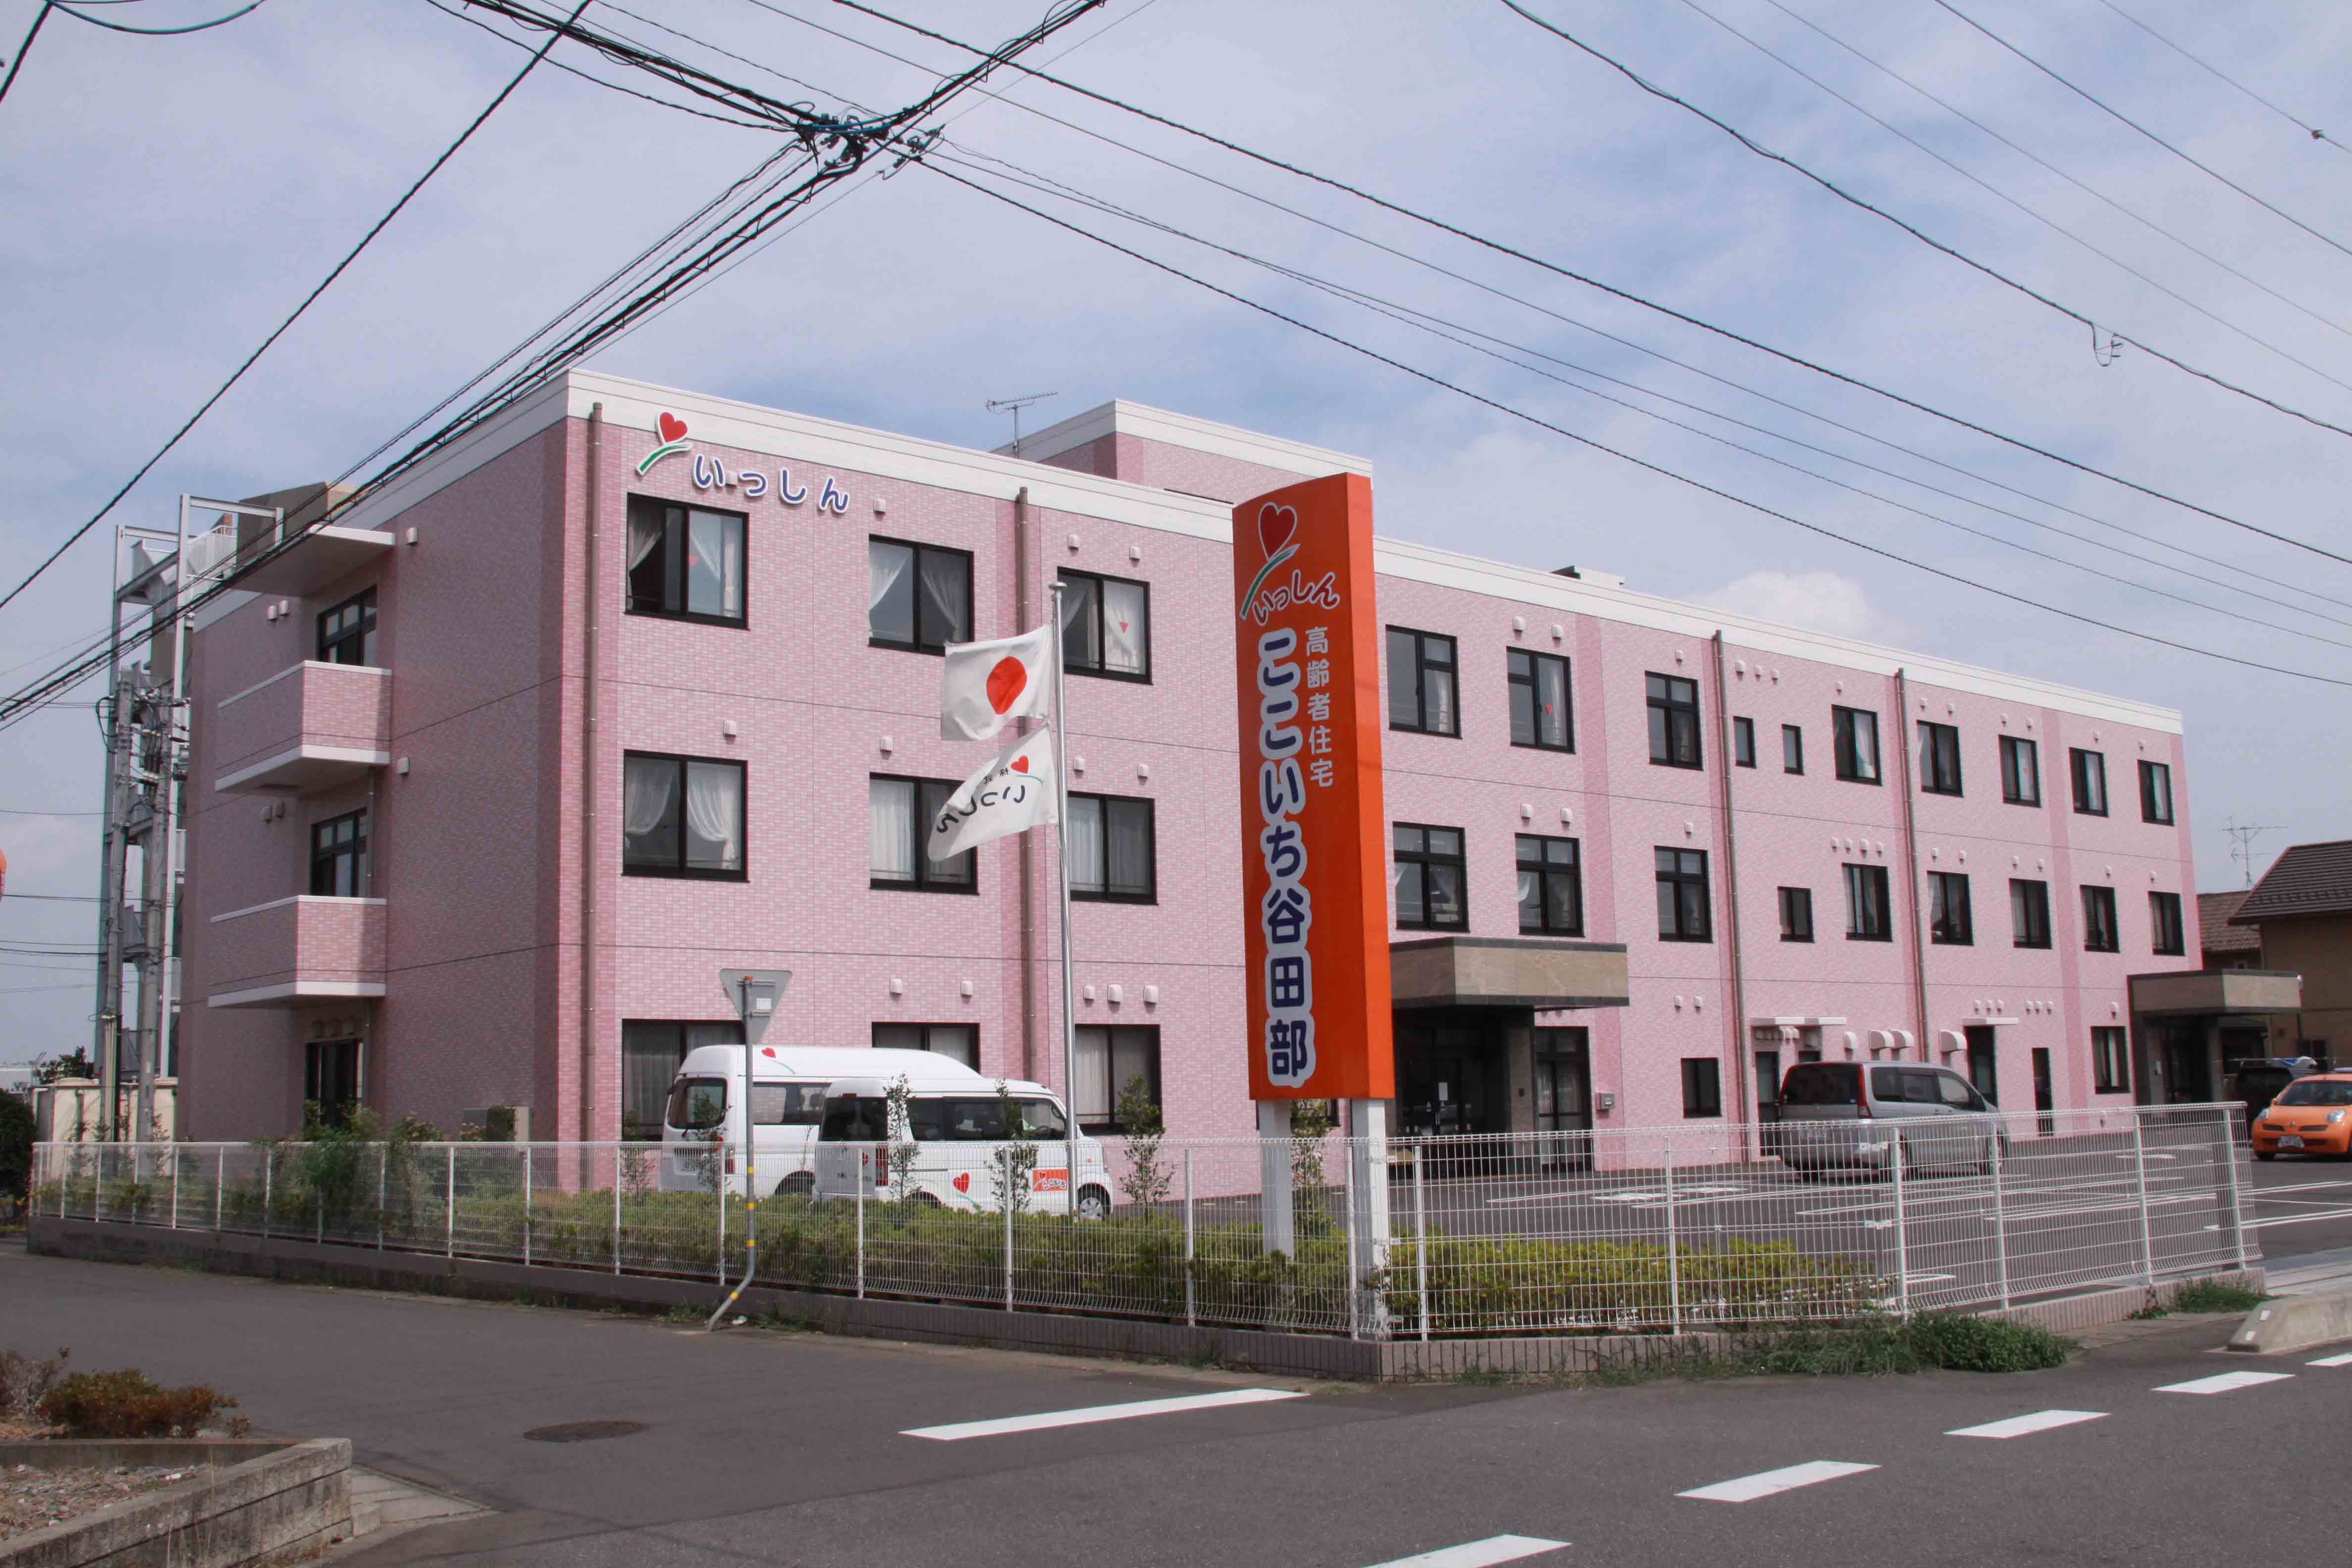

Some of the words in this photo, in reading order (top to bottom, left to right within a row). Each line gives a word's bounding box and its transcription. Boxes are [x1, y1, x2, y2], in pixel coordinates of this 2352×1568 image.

[693, 454, 849, 513] いっしん
[1253, 570, 1339, 626] いっしん
[1305, 626, 1333, 787] 高齢者住宅
[1260, 632, 1312, 1083] ここいち谷田部
